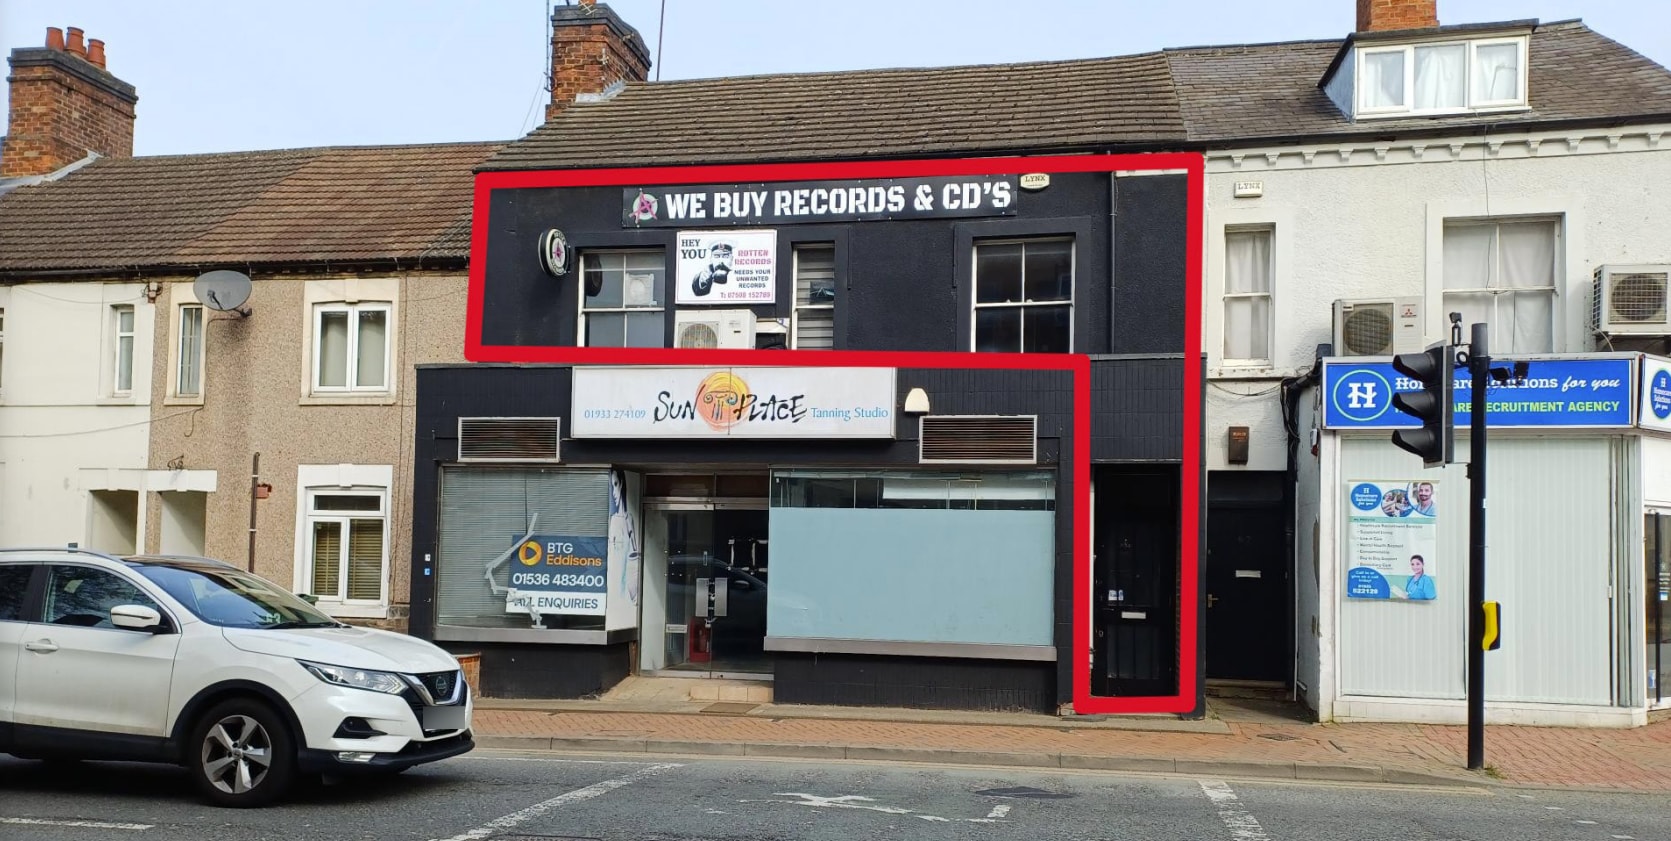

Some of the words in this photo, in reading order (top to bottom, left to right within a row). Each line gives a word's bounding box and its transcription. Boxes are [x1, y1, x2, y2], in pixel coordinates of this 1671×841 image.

[665, 193, 706, 219] WE
[713, 191, 768, 218] BUY
[774, 185, 906, 216] RECORDS
[913, 184, 935, 211] &
[942, 181, 1011, 210] CD'S
[681, 239, 701, 247] HEY
[681, 249, 707, 259] YOU
[734, 258, 772, 266] RECORDS
[1561, 375, 1588, 392] for
[1591, 378, 1620, 391] you
[1485, 402, 1564, 413] ECRUITMENT
[1567, 401, 1620, 412] AGENCY
[584, 409, 611, 419] 01933
[613, 409, 646, 419] 274109
[811, 407, 851, 421] Tanning
[854, 407, 888, 418] Studio
[547, 542, 573, 554] BTG
[546, 554, 602, 567] Eddisons
[512, 572, 550, 586] 01536
[552, 574, 605, 587] 483400
[537, 597, 599, 609] ENQUIRIES
